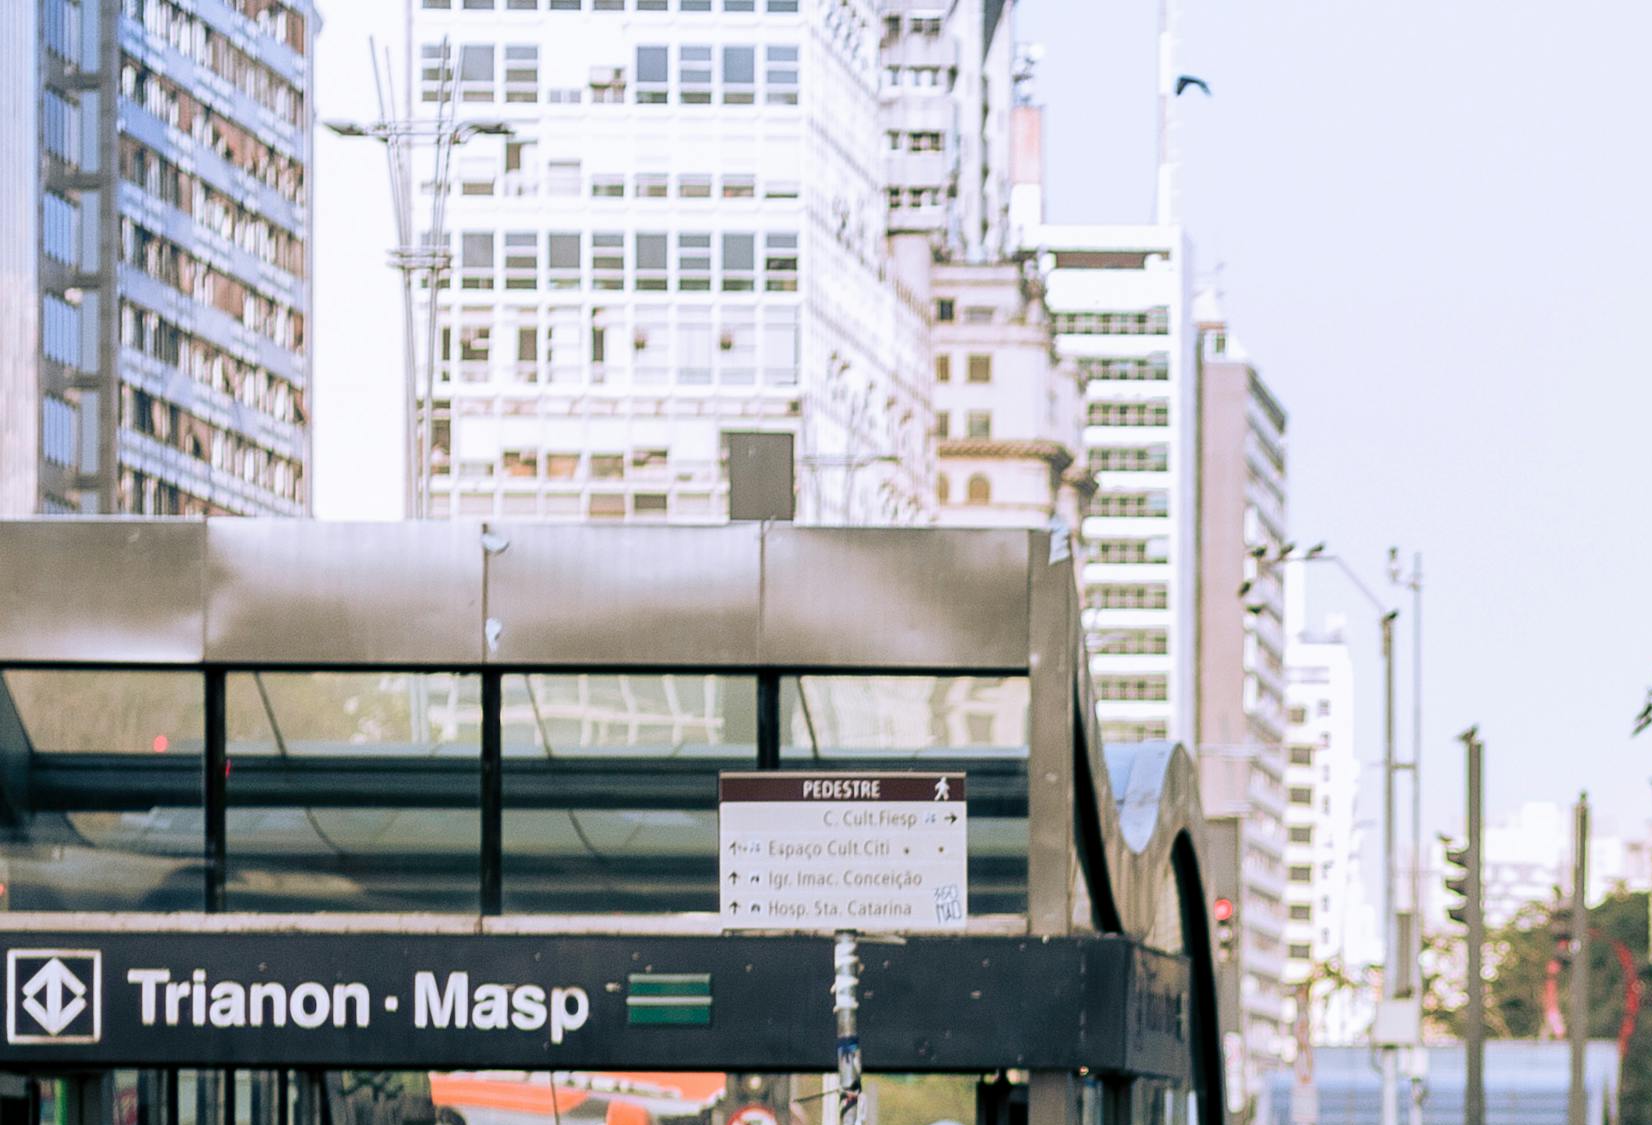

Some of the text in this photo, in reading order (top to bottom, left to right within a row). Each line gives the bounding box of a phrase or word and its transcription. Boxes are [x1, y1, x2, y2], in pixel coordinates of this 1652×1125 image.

[802, 780, 880, 799] PEDESTRE
[823, 809, 839, 827] C.
[768, 838, 822, 861] Espaço
[768, 868, 923, 890] Igr. Imac. Conceição
[768, 900, 913, 920] Hosp. Sta. Catarina
[127, 968, 590, 1044] Trianon Masp
